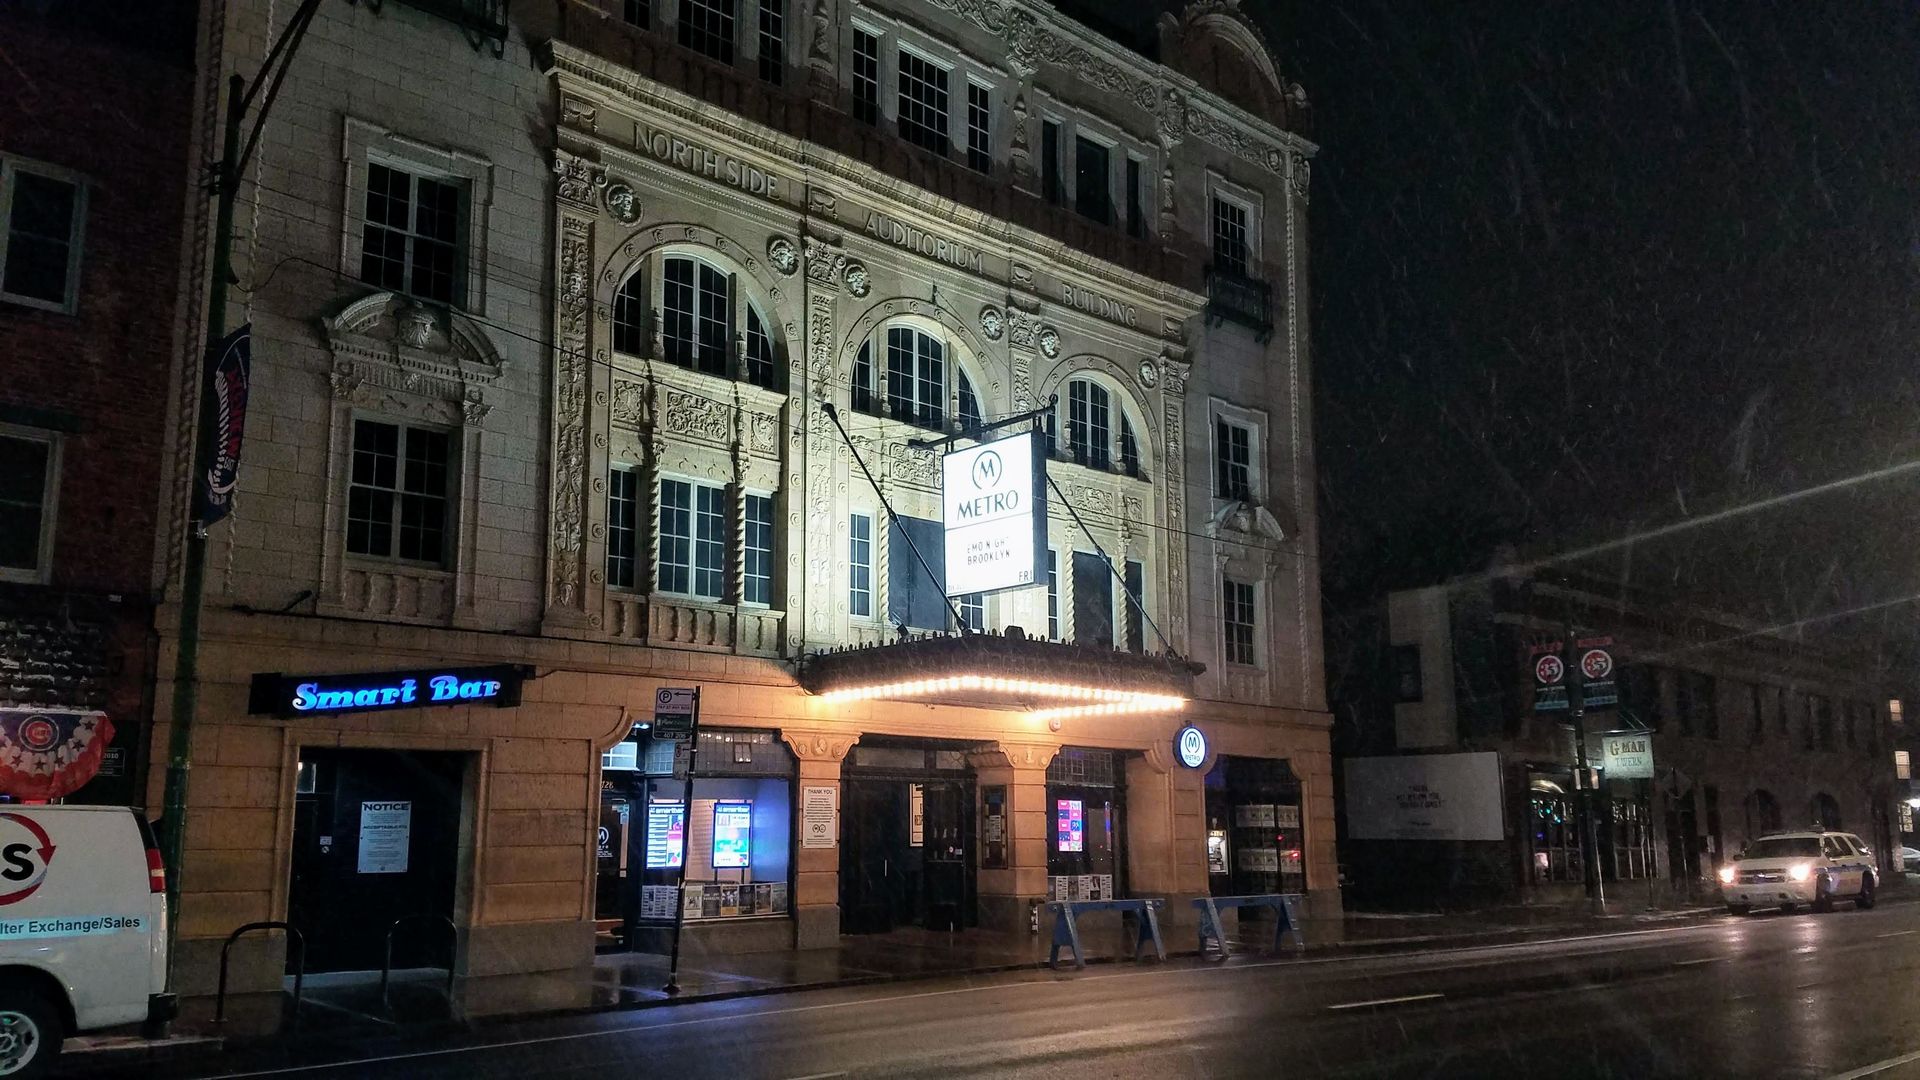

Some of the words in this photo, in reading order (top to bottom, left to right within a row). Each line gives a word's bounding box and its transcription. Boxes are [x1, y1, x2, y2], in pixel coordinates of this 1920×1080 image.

[634, 122, 720, 180] NORTH
[726, 160, 782, 201] SIDE
[865, 210, 984, 274] AUDITORIUM
[1061, 283, 1137, 327] BUILDING
[958, 490, 1018, 520] METRO
[967, 549, 1010, 566] BROOKLYN
[292, 679, 416, 711] Smart
[429, 675, 501, 701] Bar
[362, 803, 410, 811] NOTICE
[28, 917, 141, 933] Exchange/Sales
